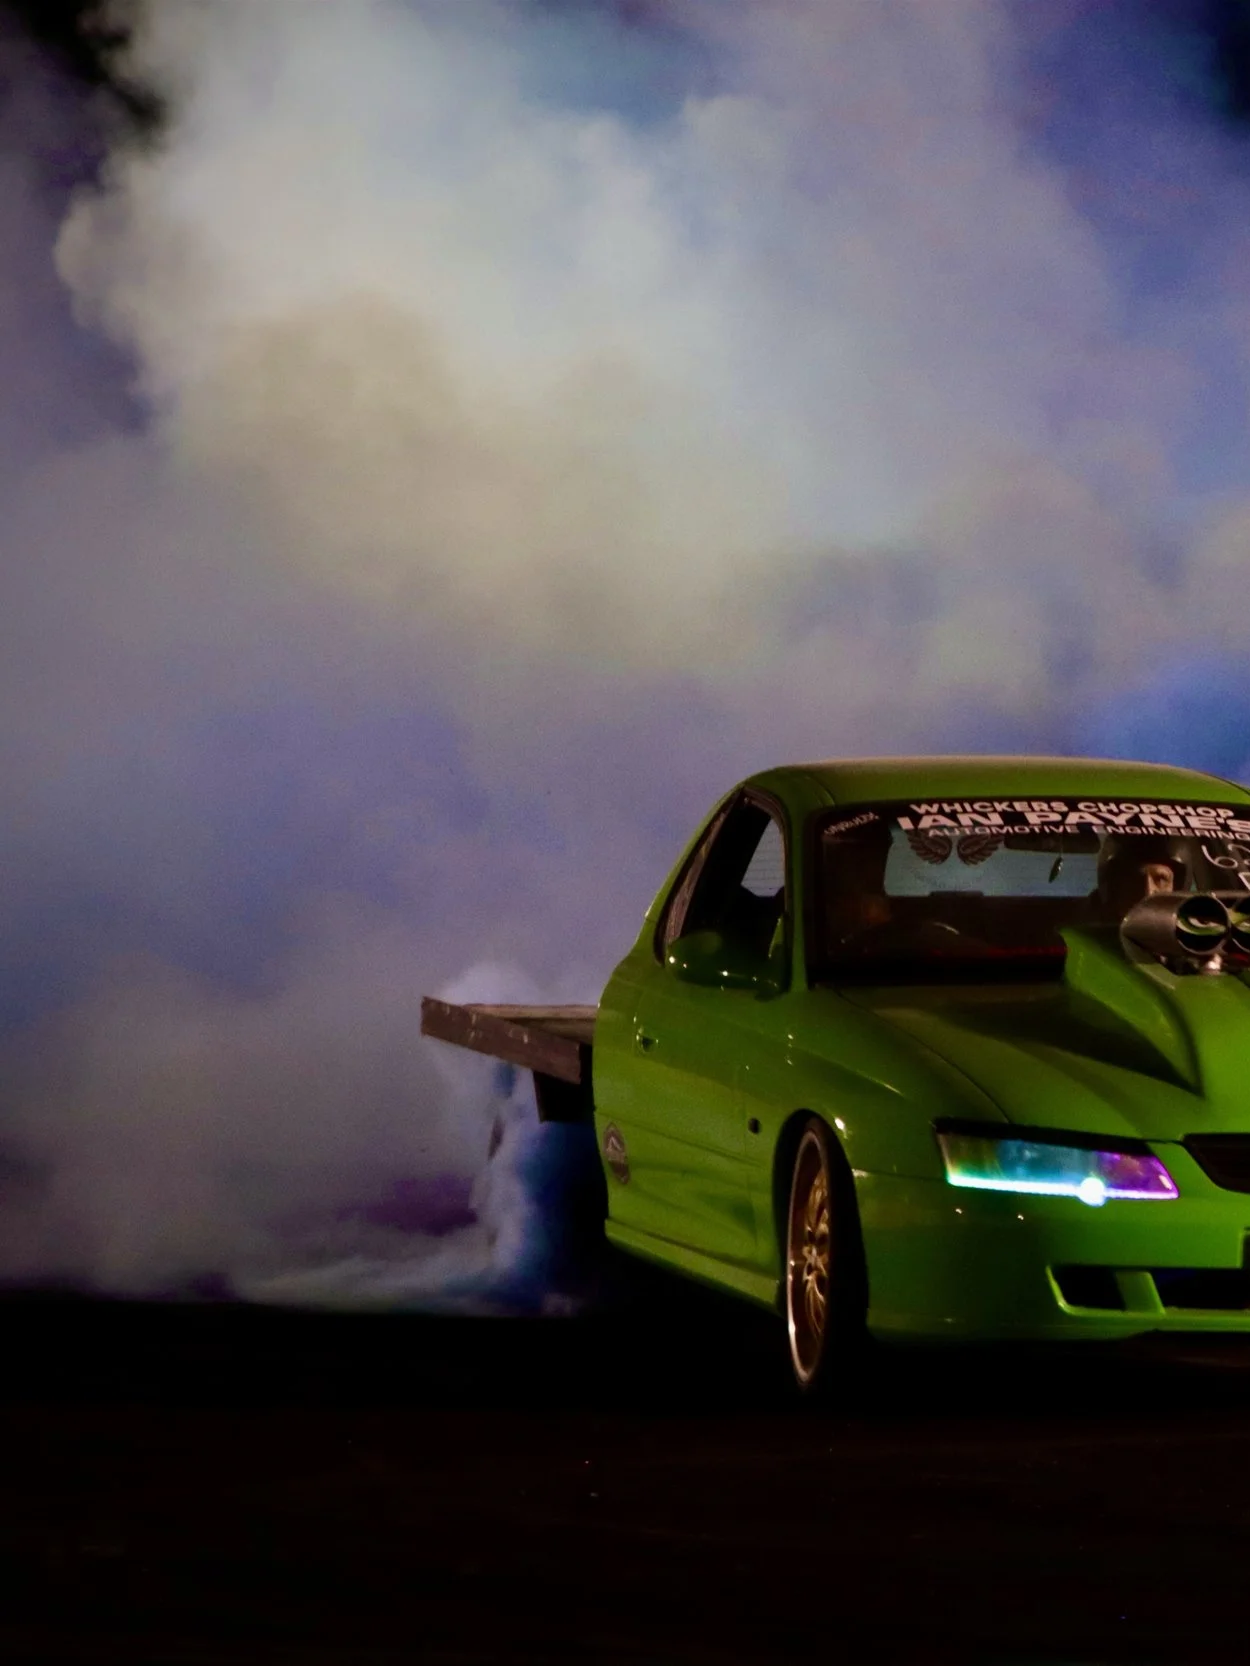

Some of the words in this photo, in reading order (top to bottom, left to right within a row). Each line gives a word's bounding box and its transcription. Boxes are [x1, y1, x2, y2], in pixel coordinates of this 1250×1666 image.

[910, 801, 1069, 815] WHICKERS
[1077, 802, 1235, 819] CHOPSHOP
[897, 812, 1004, 830] IAN
[928, 825, 1080, 838] AUTOMOTIVE
